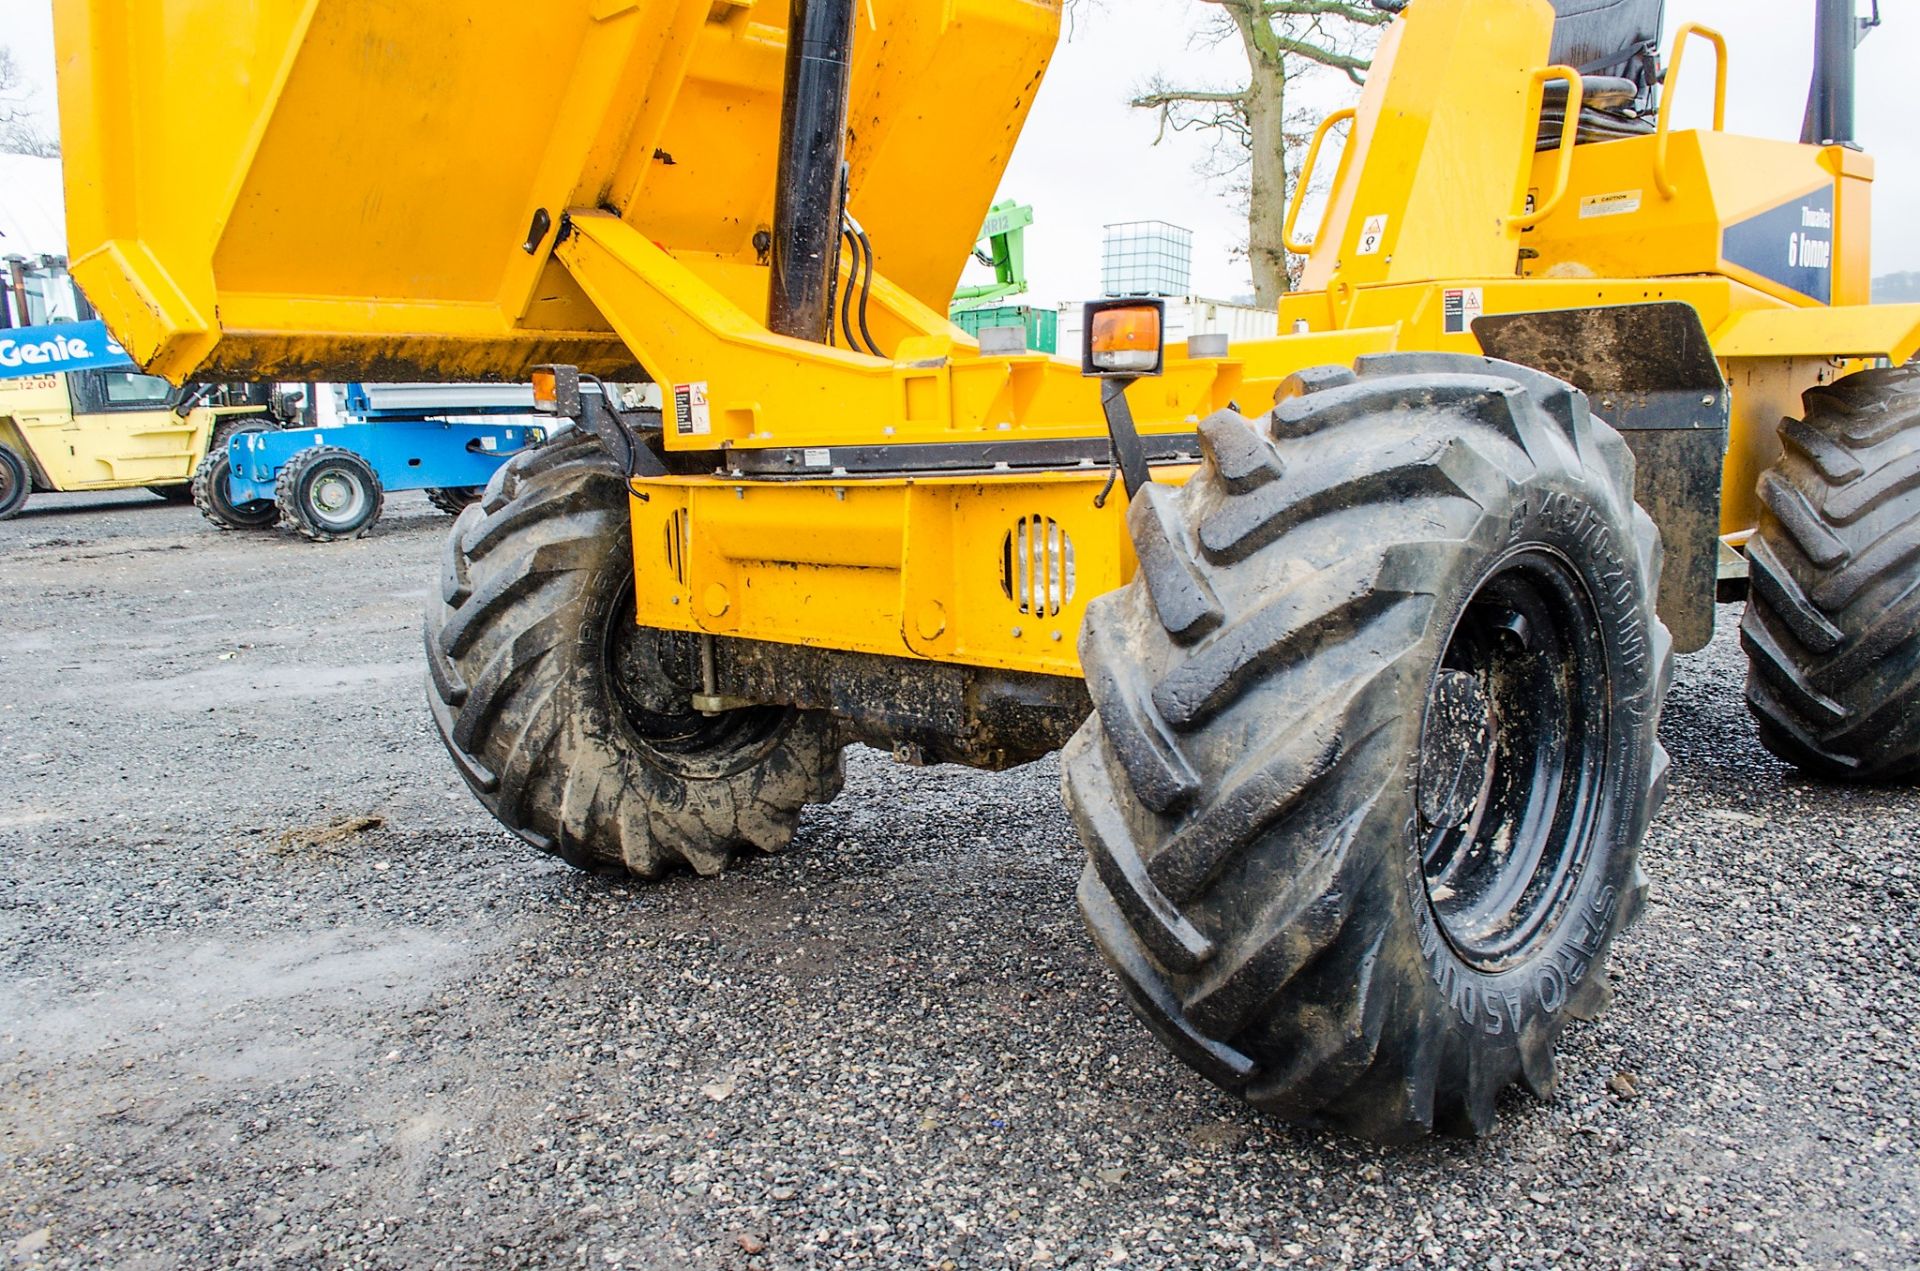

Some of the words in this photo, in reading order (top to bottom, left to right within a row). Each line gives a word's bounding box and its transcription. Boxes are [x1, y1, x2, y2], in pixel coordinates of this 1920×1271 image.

[1601, 194, 1627, 203] CAUTION
[1788, 232, 1798, 267] 6
[1799, 232, 1831, 269] tonne
[0, 334, 89, 367] Genie
